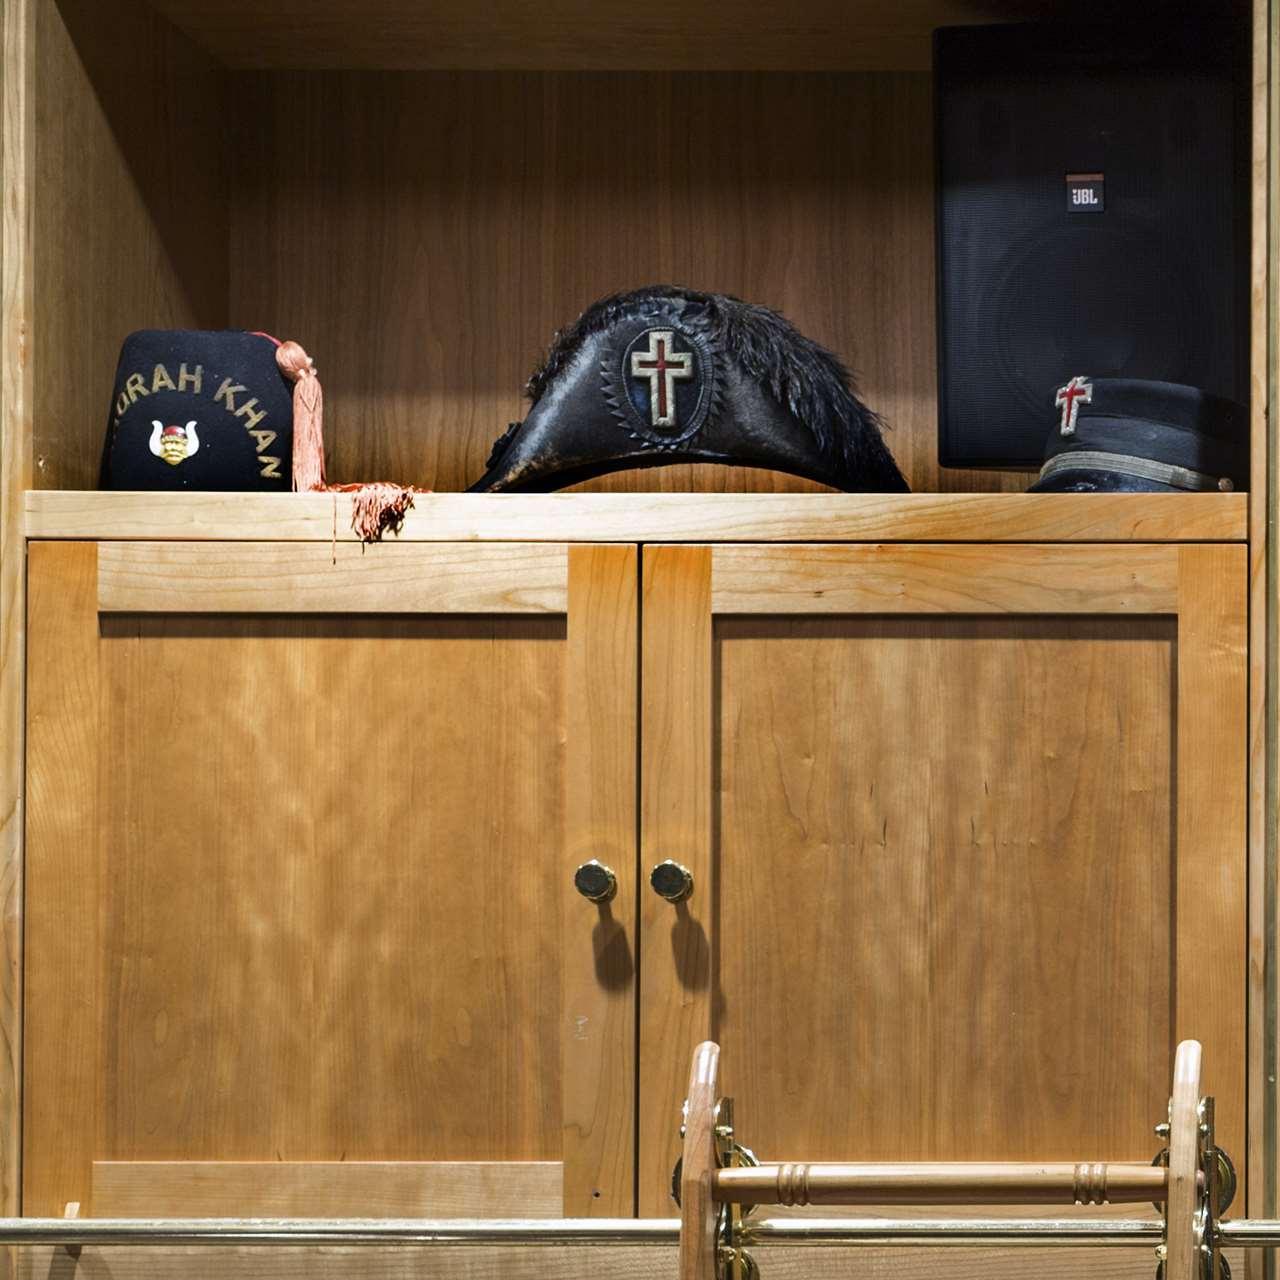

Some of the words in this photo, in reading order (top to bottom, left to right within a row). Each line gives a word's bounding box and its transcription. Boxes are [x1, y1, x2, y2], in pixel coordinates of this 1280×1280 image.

[1072, 188, 1098, 205] JBL
[114, 362, 202, 426] ORAH
[214, 377, 281, 478] KHAN
